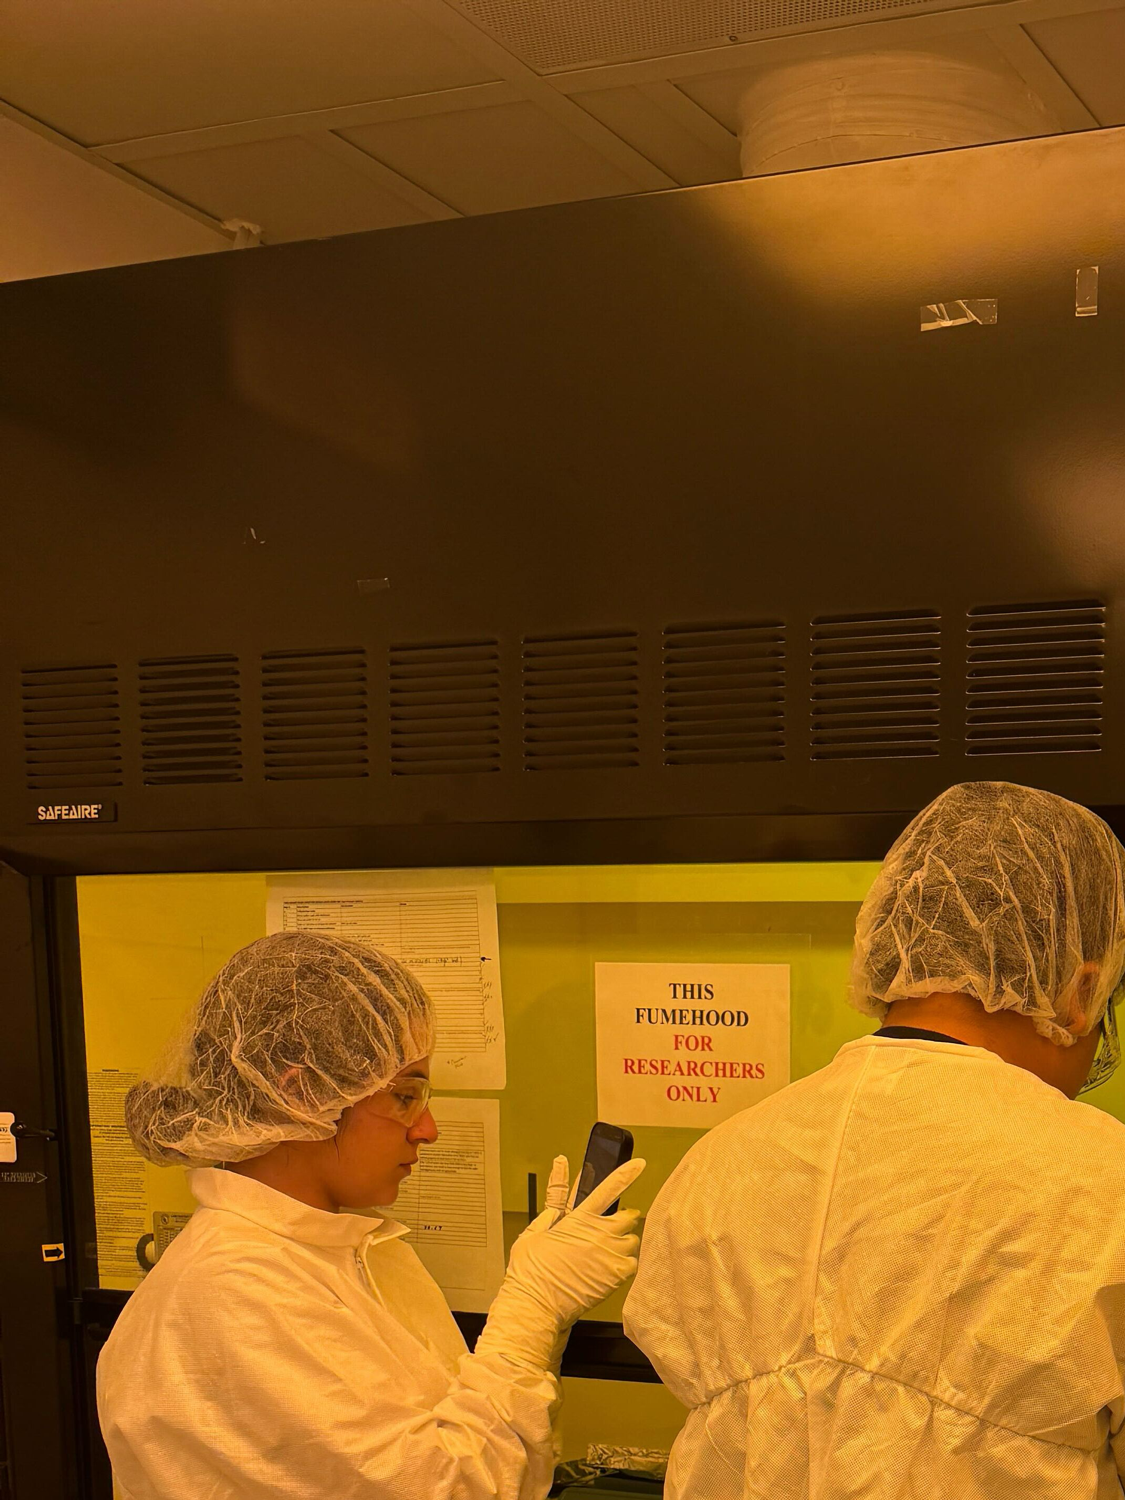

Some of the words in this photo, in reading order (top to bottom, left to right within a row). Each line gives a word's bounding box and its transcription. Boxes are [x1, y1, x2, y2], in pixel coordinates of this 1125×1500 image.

[669, 983, 714, 1000] THIS
[635, 1007, 749, 1027] FUMEHOOD
[673, 1034, 714, 1051] FOR
[623, 1058, 765, 1079] RESEARCHERS
[666, 1085, 721, 1103] ONLY
